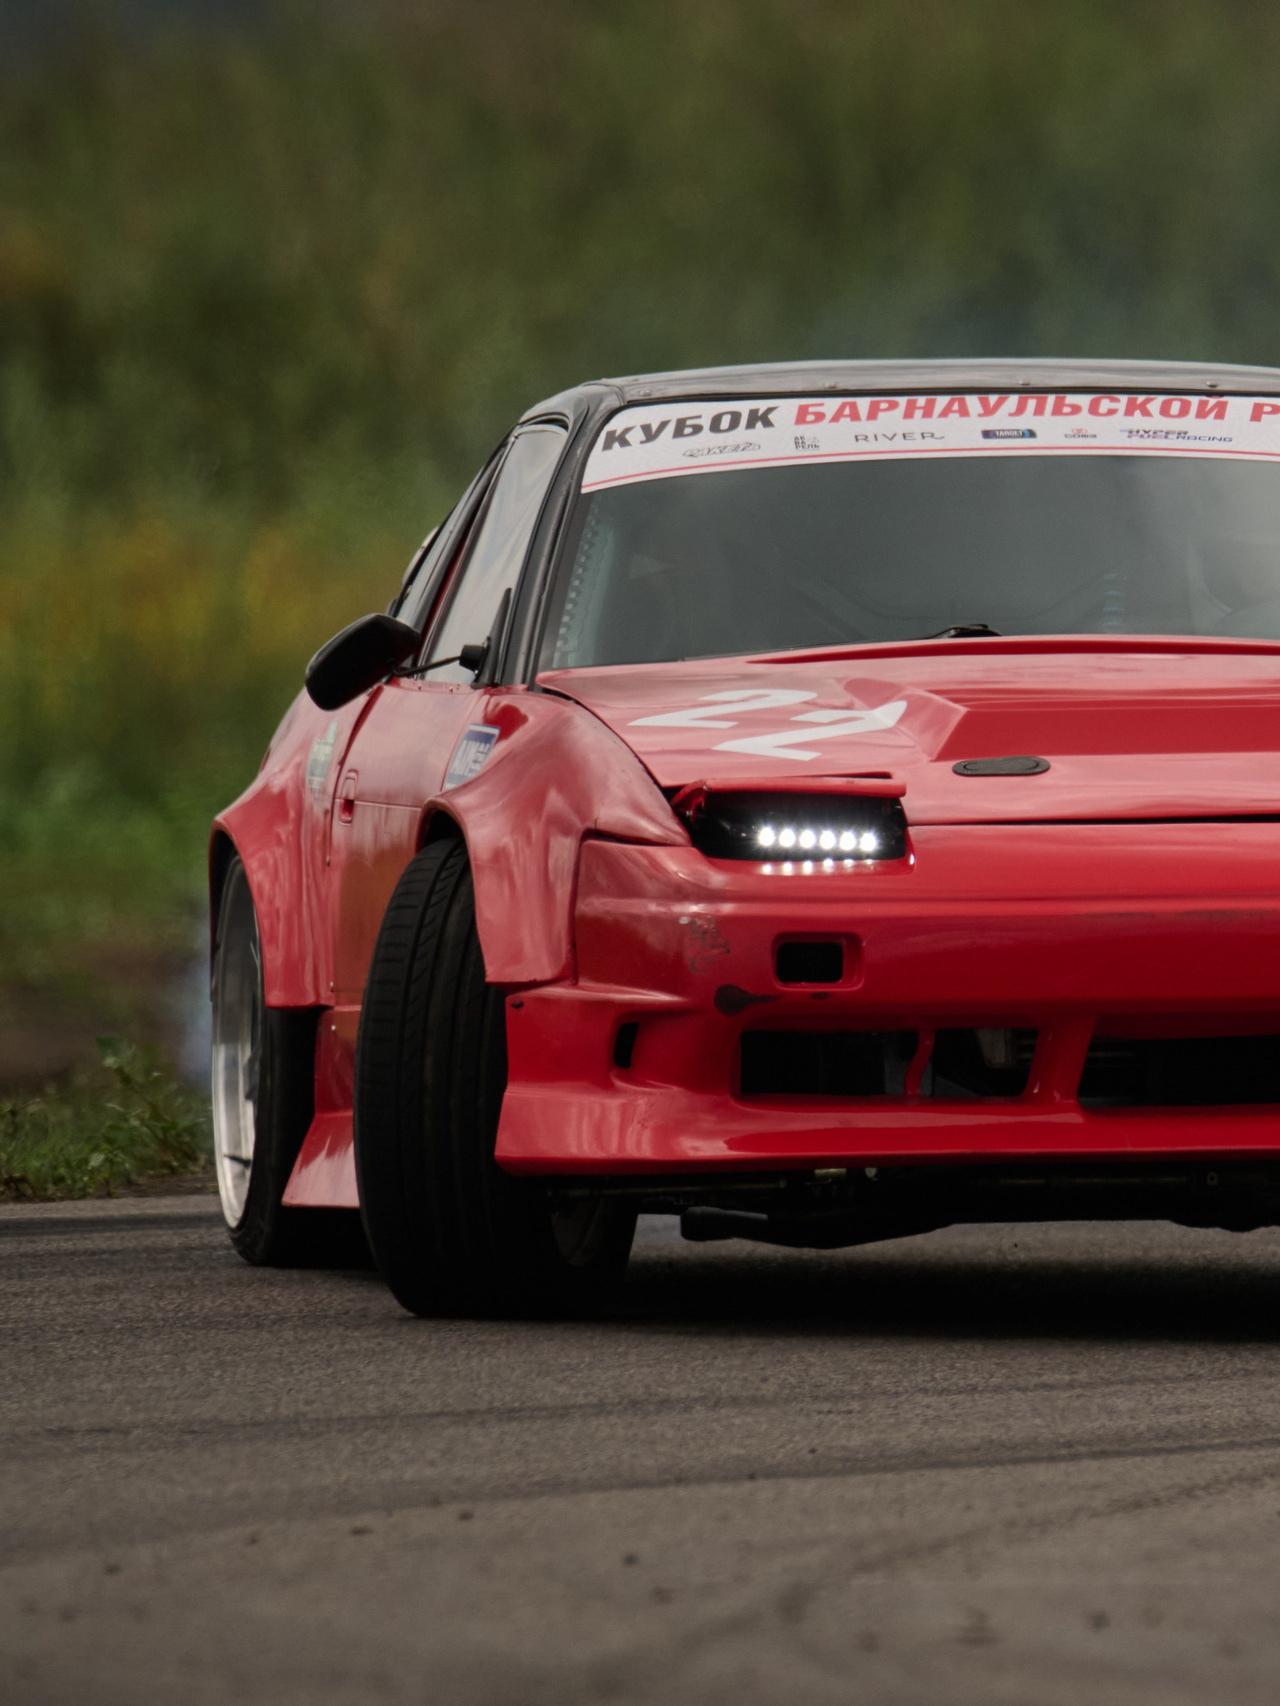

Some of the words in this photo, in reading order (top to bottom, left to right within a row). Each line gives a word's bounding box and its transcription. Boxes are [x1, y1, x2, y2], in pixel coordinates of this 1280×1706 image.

[602, 406, 780, 451] КУБОК
[793, 395, 1229, 426] БАРНАУЛЬСКОЙ
[854, 431, 945, 443] RIVER
